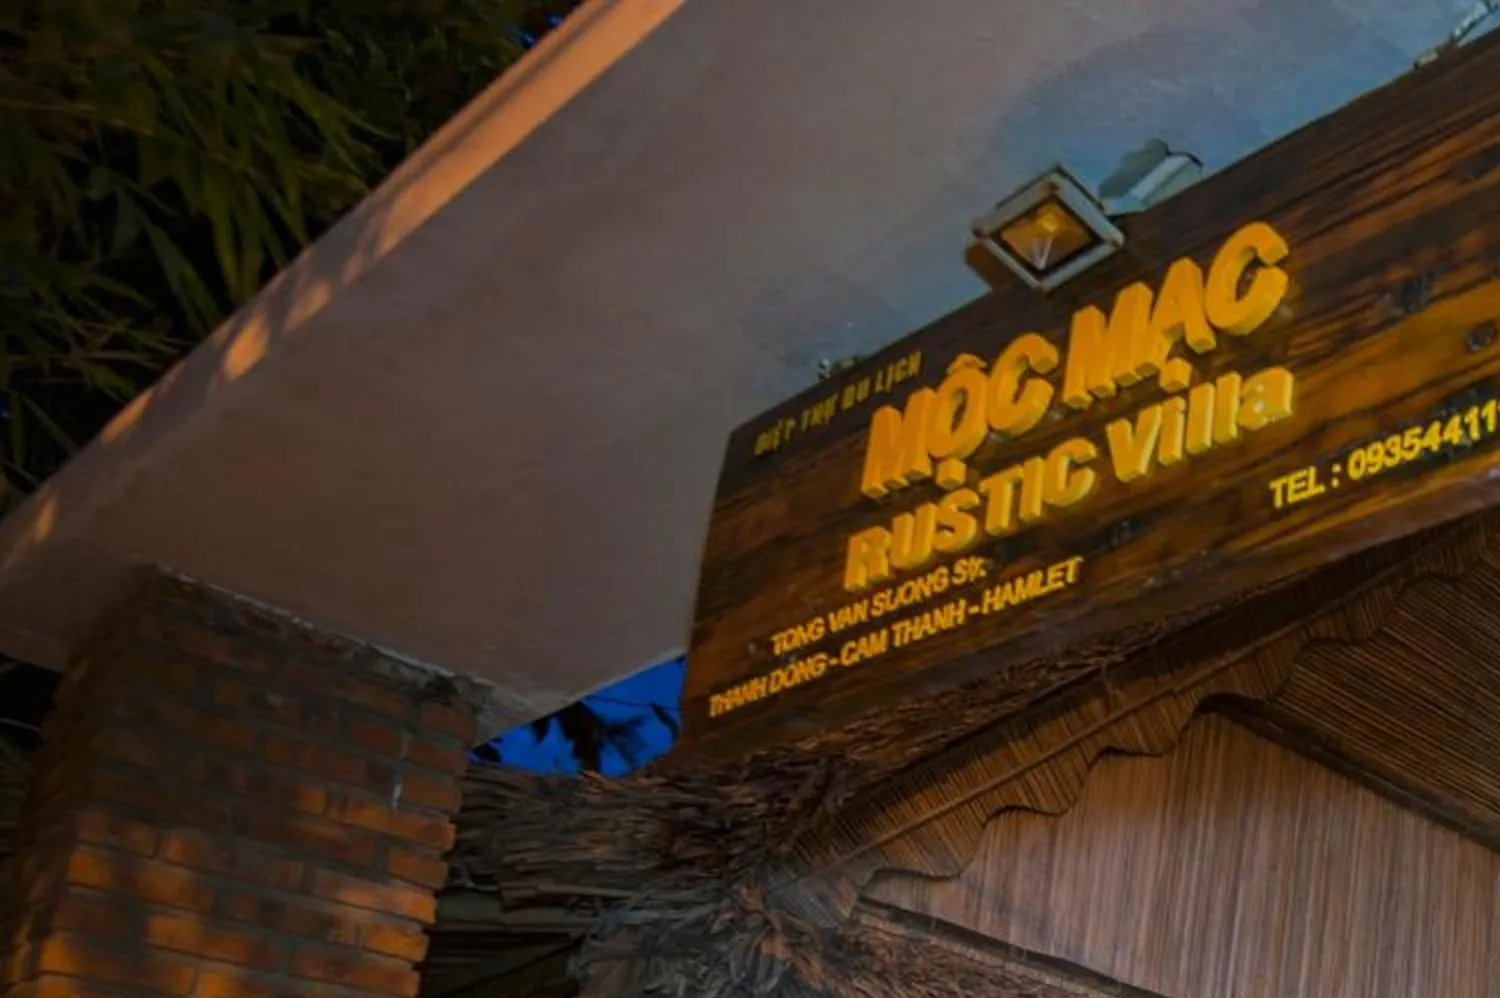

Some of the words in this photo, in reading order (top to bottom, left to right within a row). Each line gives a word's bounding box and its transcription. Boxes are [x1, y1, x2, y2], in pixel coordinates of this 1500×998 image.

[861, 333, 1059, 499] MỘC
[1063, 221, 1289, 410] MẠC
[843, 436, 1098, 592] RUSTIC
[1106, 366, 1295, 482] Villa
[769, 616, 826, 656] TONG
[828, 598, 869, 633] VAN
[892, 597, 967, 648] THANH
